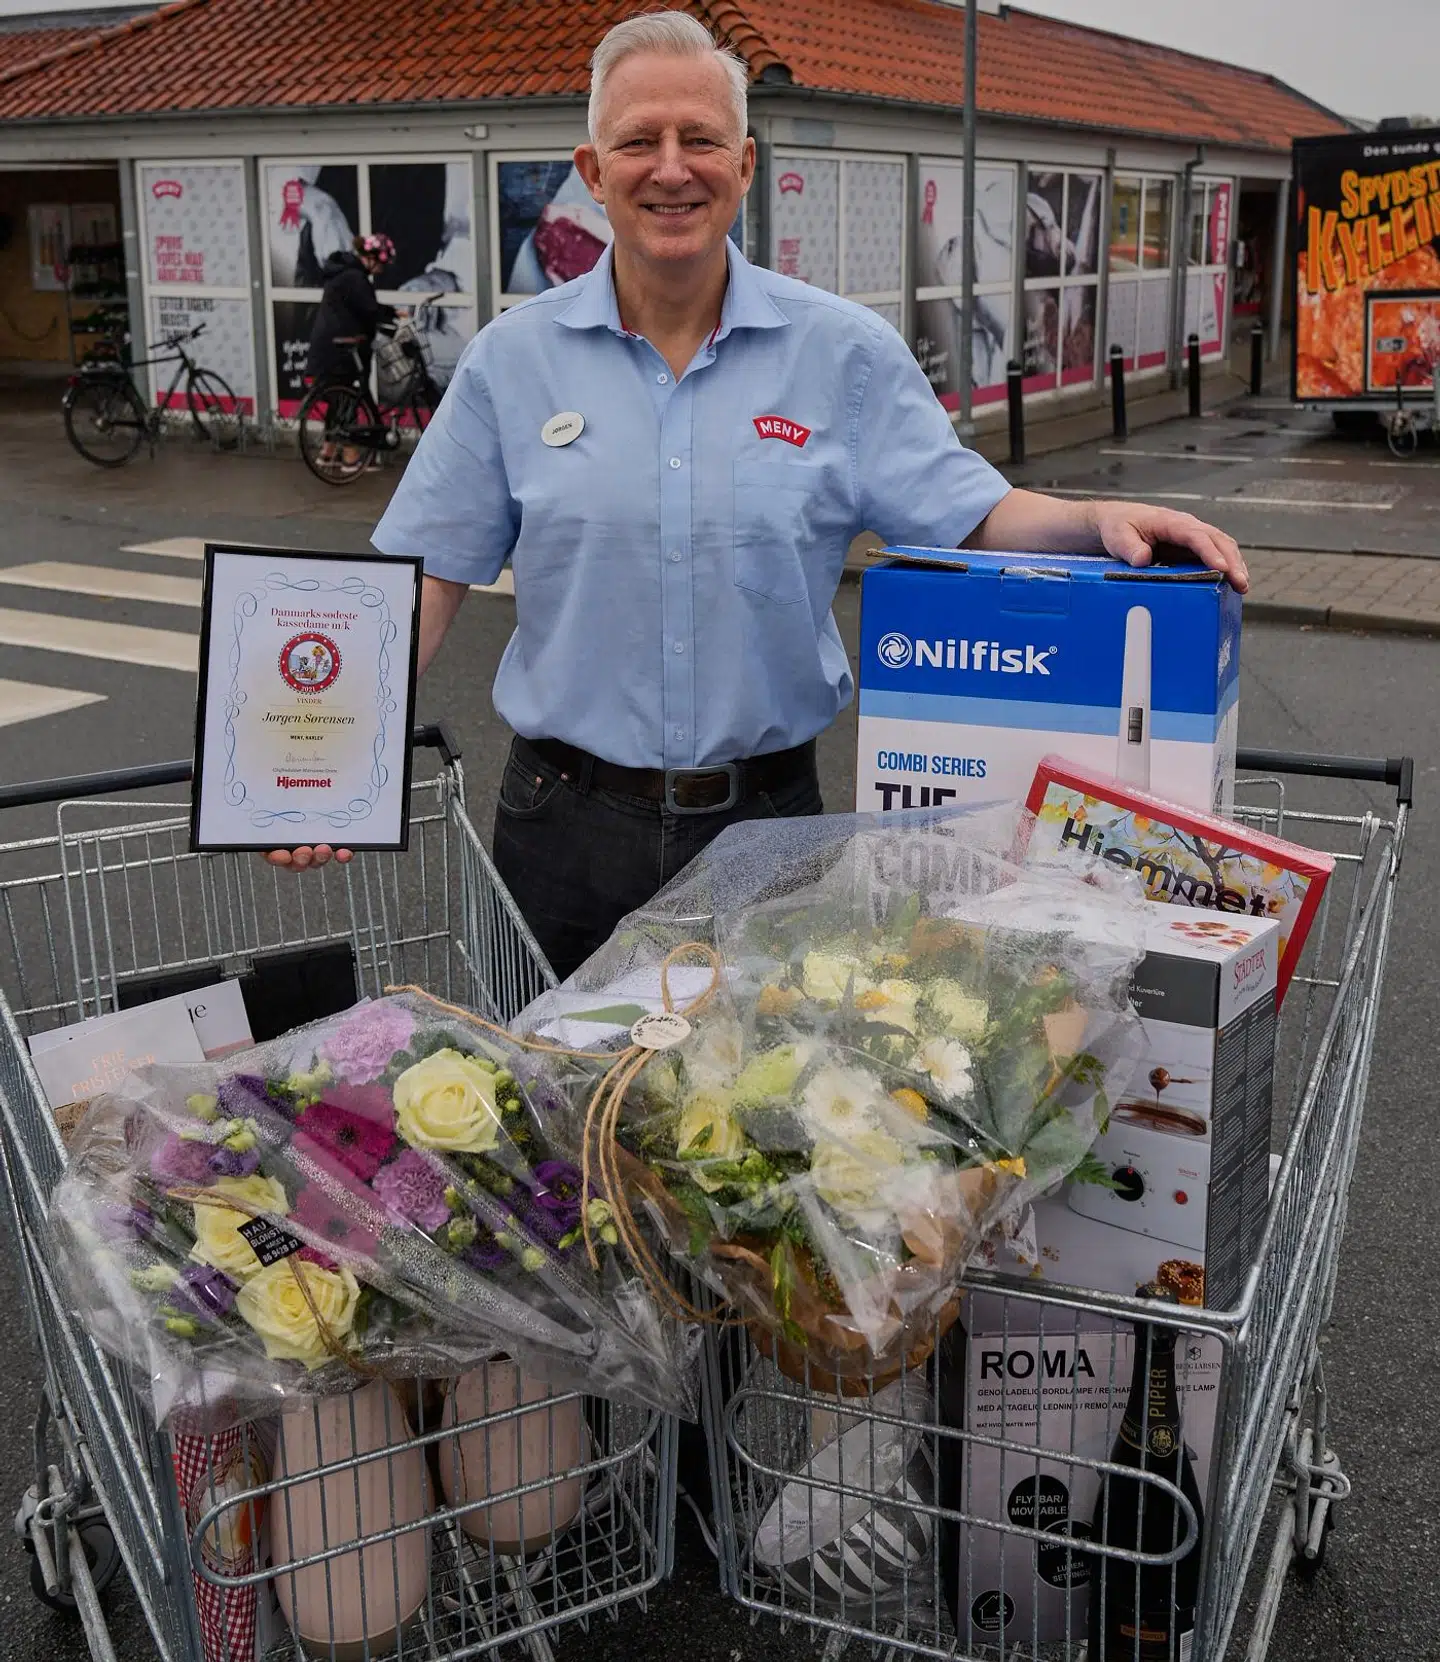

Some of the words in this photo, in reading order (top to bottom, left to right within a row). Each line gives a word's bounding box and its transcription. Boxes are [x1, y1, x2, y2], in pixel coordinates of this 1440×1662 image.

[1363, 145, 1389, 157] Den
[1391, 143, 1430, 155] sunde
[760, 420, 804, 441] MENY
[271, 607, 321, 618] Danmarks
[277, 618, 330, 629] kassedame
[331, 621, 350, 630] m/k
[261, 712, 301, 725] Jørgen
[303, 712, 355, 725] Sørensen
[877, 750, 927, 773] COMBI
[931, 755, 987, 778] SERIES
[277, 776, 331, 789] Hjemmet
[980, 1349, 1095, 1380] ROMA
[1149, 1367, 1168, 1418] PIPER
[1193, 1384, 1216, 1392] LAMP
[1011, 1506, 1067, 1516] MOVABLE
